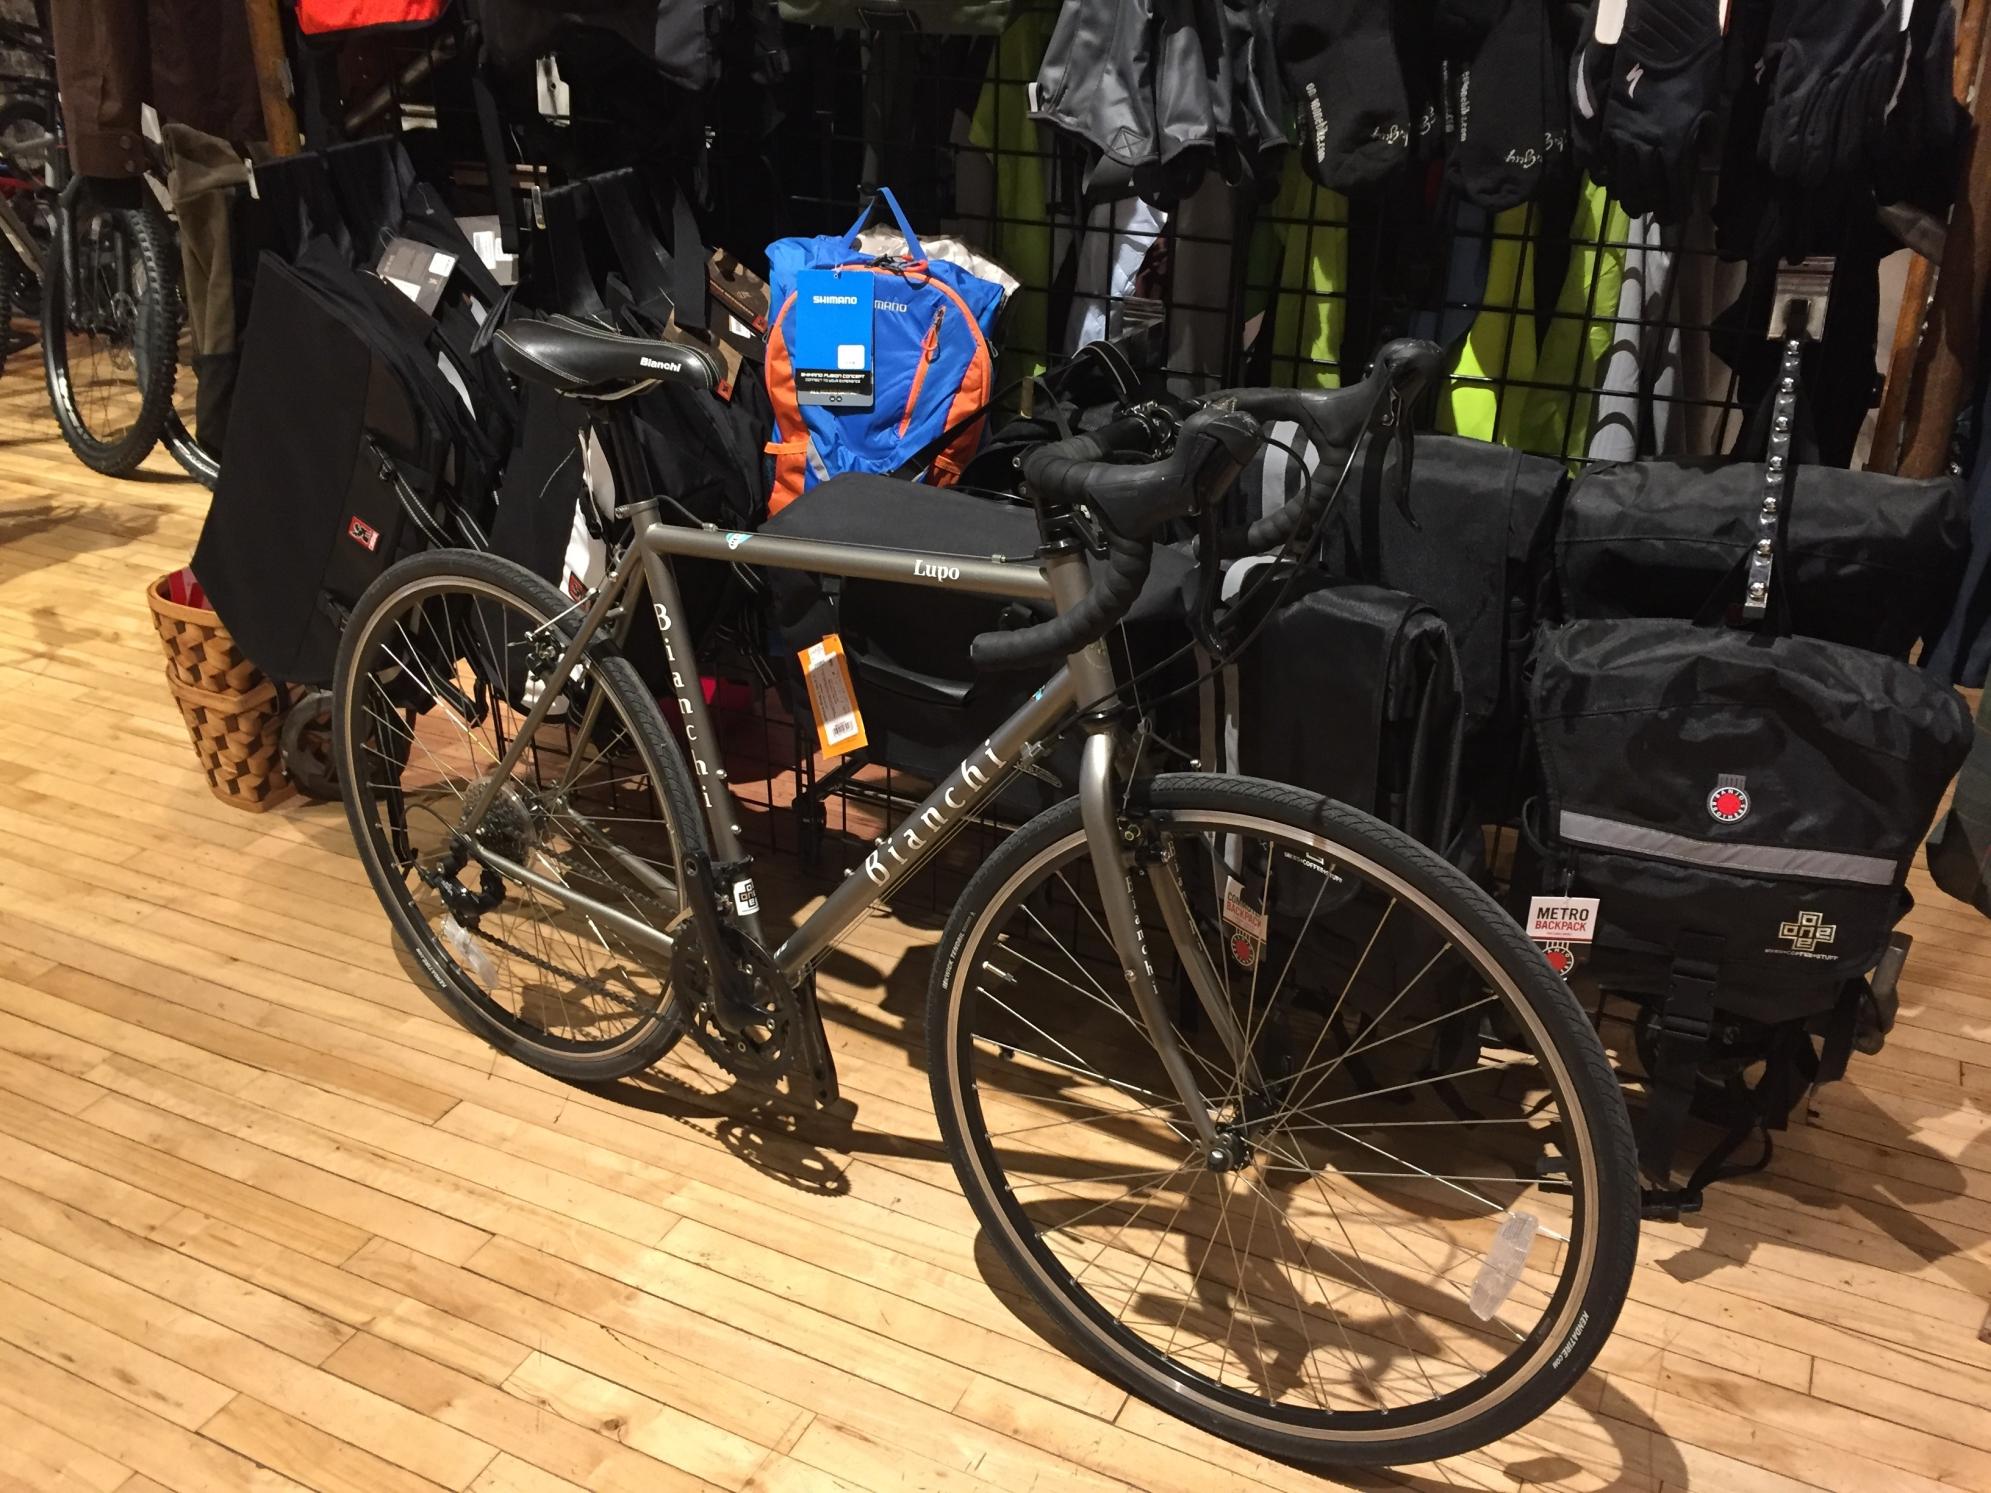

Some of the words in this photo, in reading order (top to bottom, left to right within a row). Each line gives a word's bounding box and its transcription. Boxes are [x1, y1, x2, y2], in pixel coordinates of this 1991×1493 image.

[813, 295, 858, 305] SHIMANO
[874, 299, 908, 312] MANO
[640, 356, 682, 372] Bianchi
[913, 559, 960, 582] Lupo
[654, 603, 712, 808] Bianchi
[865, 738, 1007, 887] Bianchi
[1226, 901, 1262, 928] BACKPACK
[1537, 906, 1590, 921] METRO
[1535, 920, 1588, 931] BACKPACK
[1552, 1309, 1590, 1369] KENDATIRE.COM
